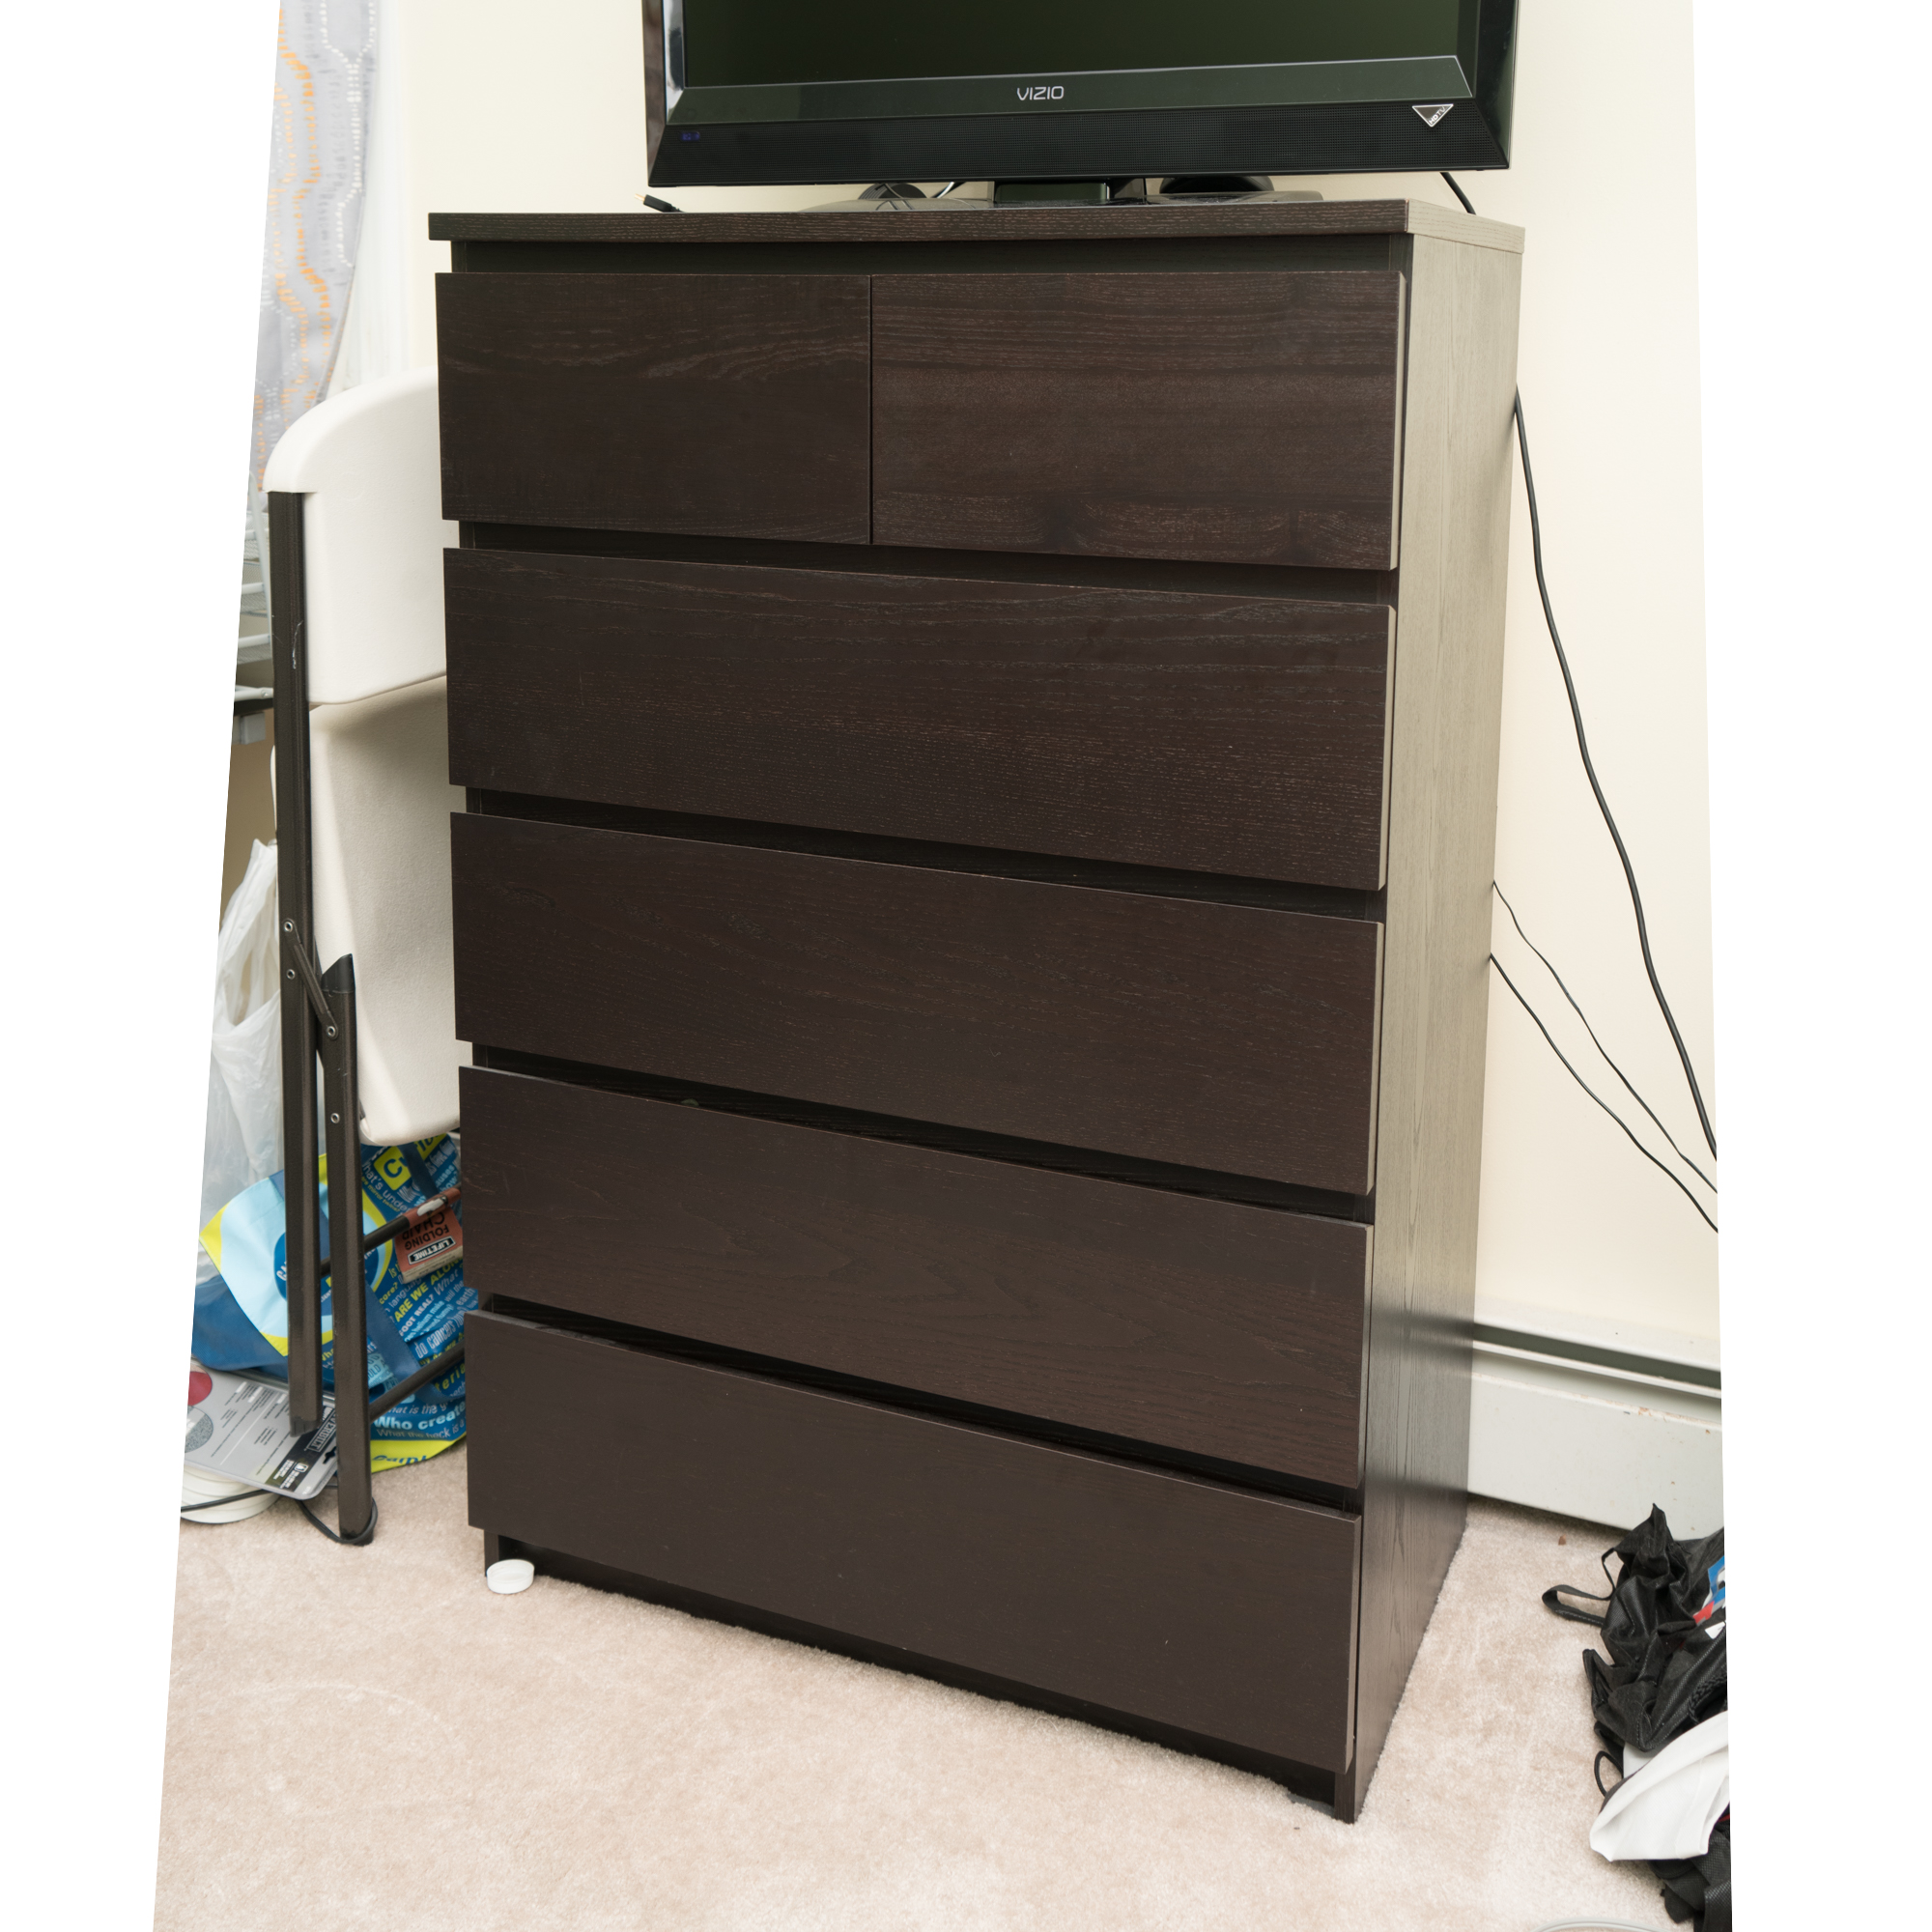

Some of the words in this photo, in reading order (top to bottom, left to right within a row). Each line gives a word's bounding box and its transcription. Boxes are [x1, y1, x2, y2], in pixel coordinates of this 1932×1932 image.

[1016, 85, 1065, 100] VIZIO
[1428, 105, 1447, 125] HDTV
[404, 1224, 450, 1250] FOLDING
[413, 1239, 450, 1261] LIFETIME
[394, 1298, 413, 1323] ARE
[411, 1282, 429, 1302] WE
[431, 1258, 463, 1286] ALON
[434, 1268, 459, 1296] What
[379, 1282, 398, 1305] core?
[413, 1293, 434, 1317] REAL?
[409, 1405, 419, 1414] is
[421, 1404, 439, 1414] the
[373, 1415, 412, 1431] Who
[377, 1428, 405, 1437] What
[452, 1423, 459, 1435] is
